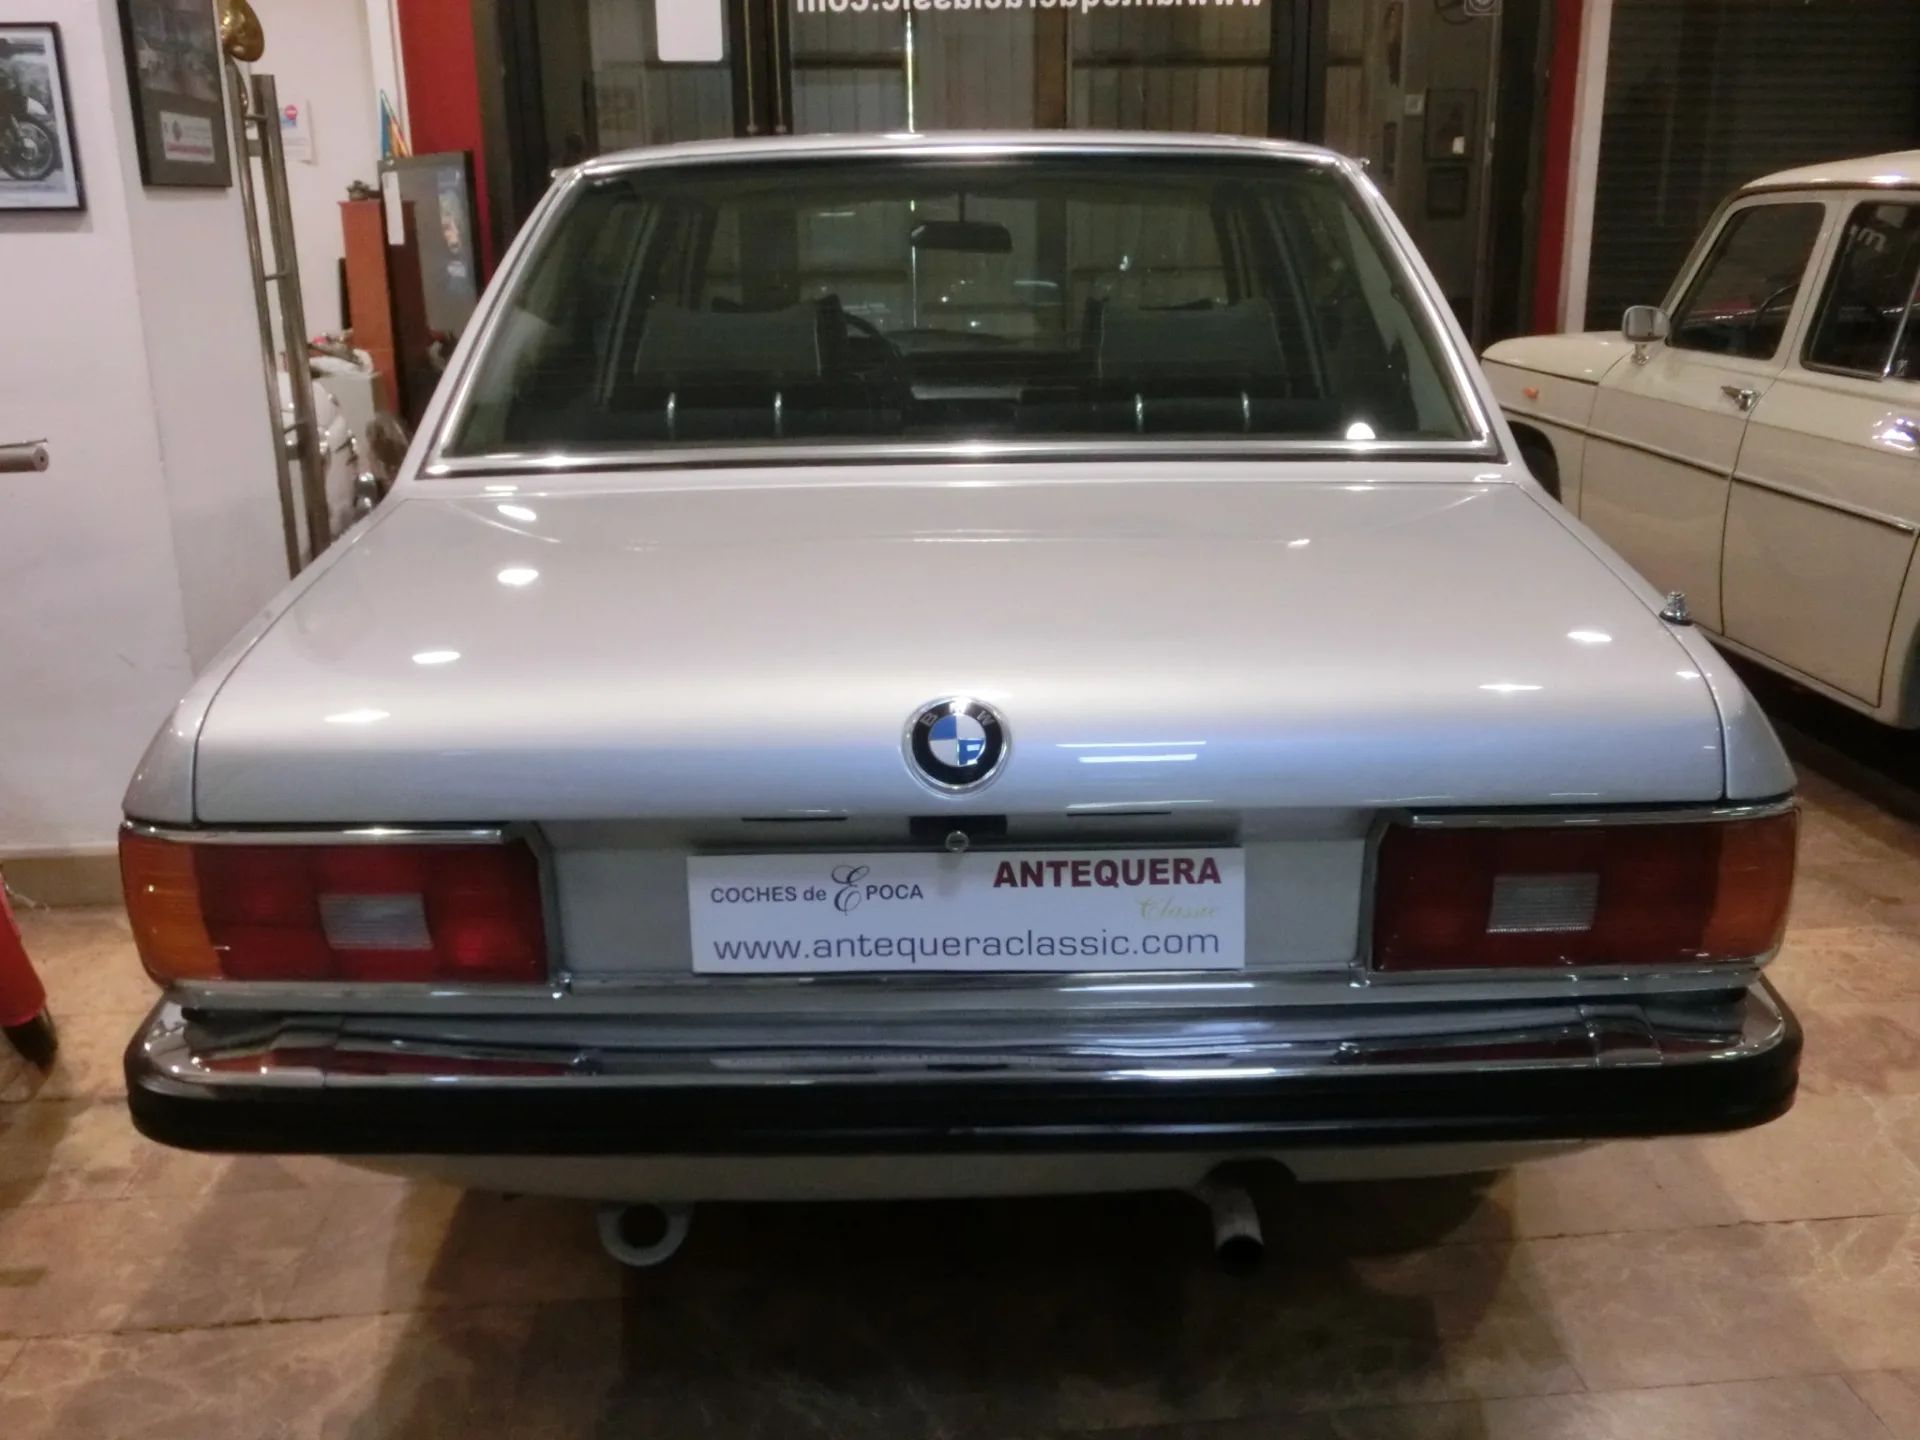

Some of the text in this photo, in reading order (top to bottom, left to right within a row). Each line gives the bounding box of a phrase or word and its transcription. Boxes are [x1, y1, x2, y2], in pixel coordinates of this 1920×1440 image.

[992, 857, 1222, 888] ANTEQUERA
[711, 886, 797, 903] COCHES
[803, 886, 827, 902] de
[713, 929, 1220, 964] www.antequeraclassic.com
